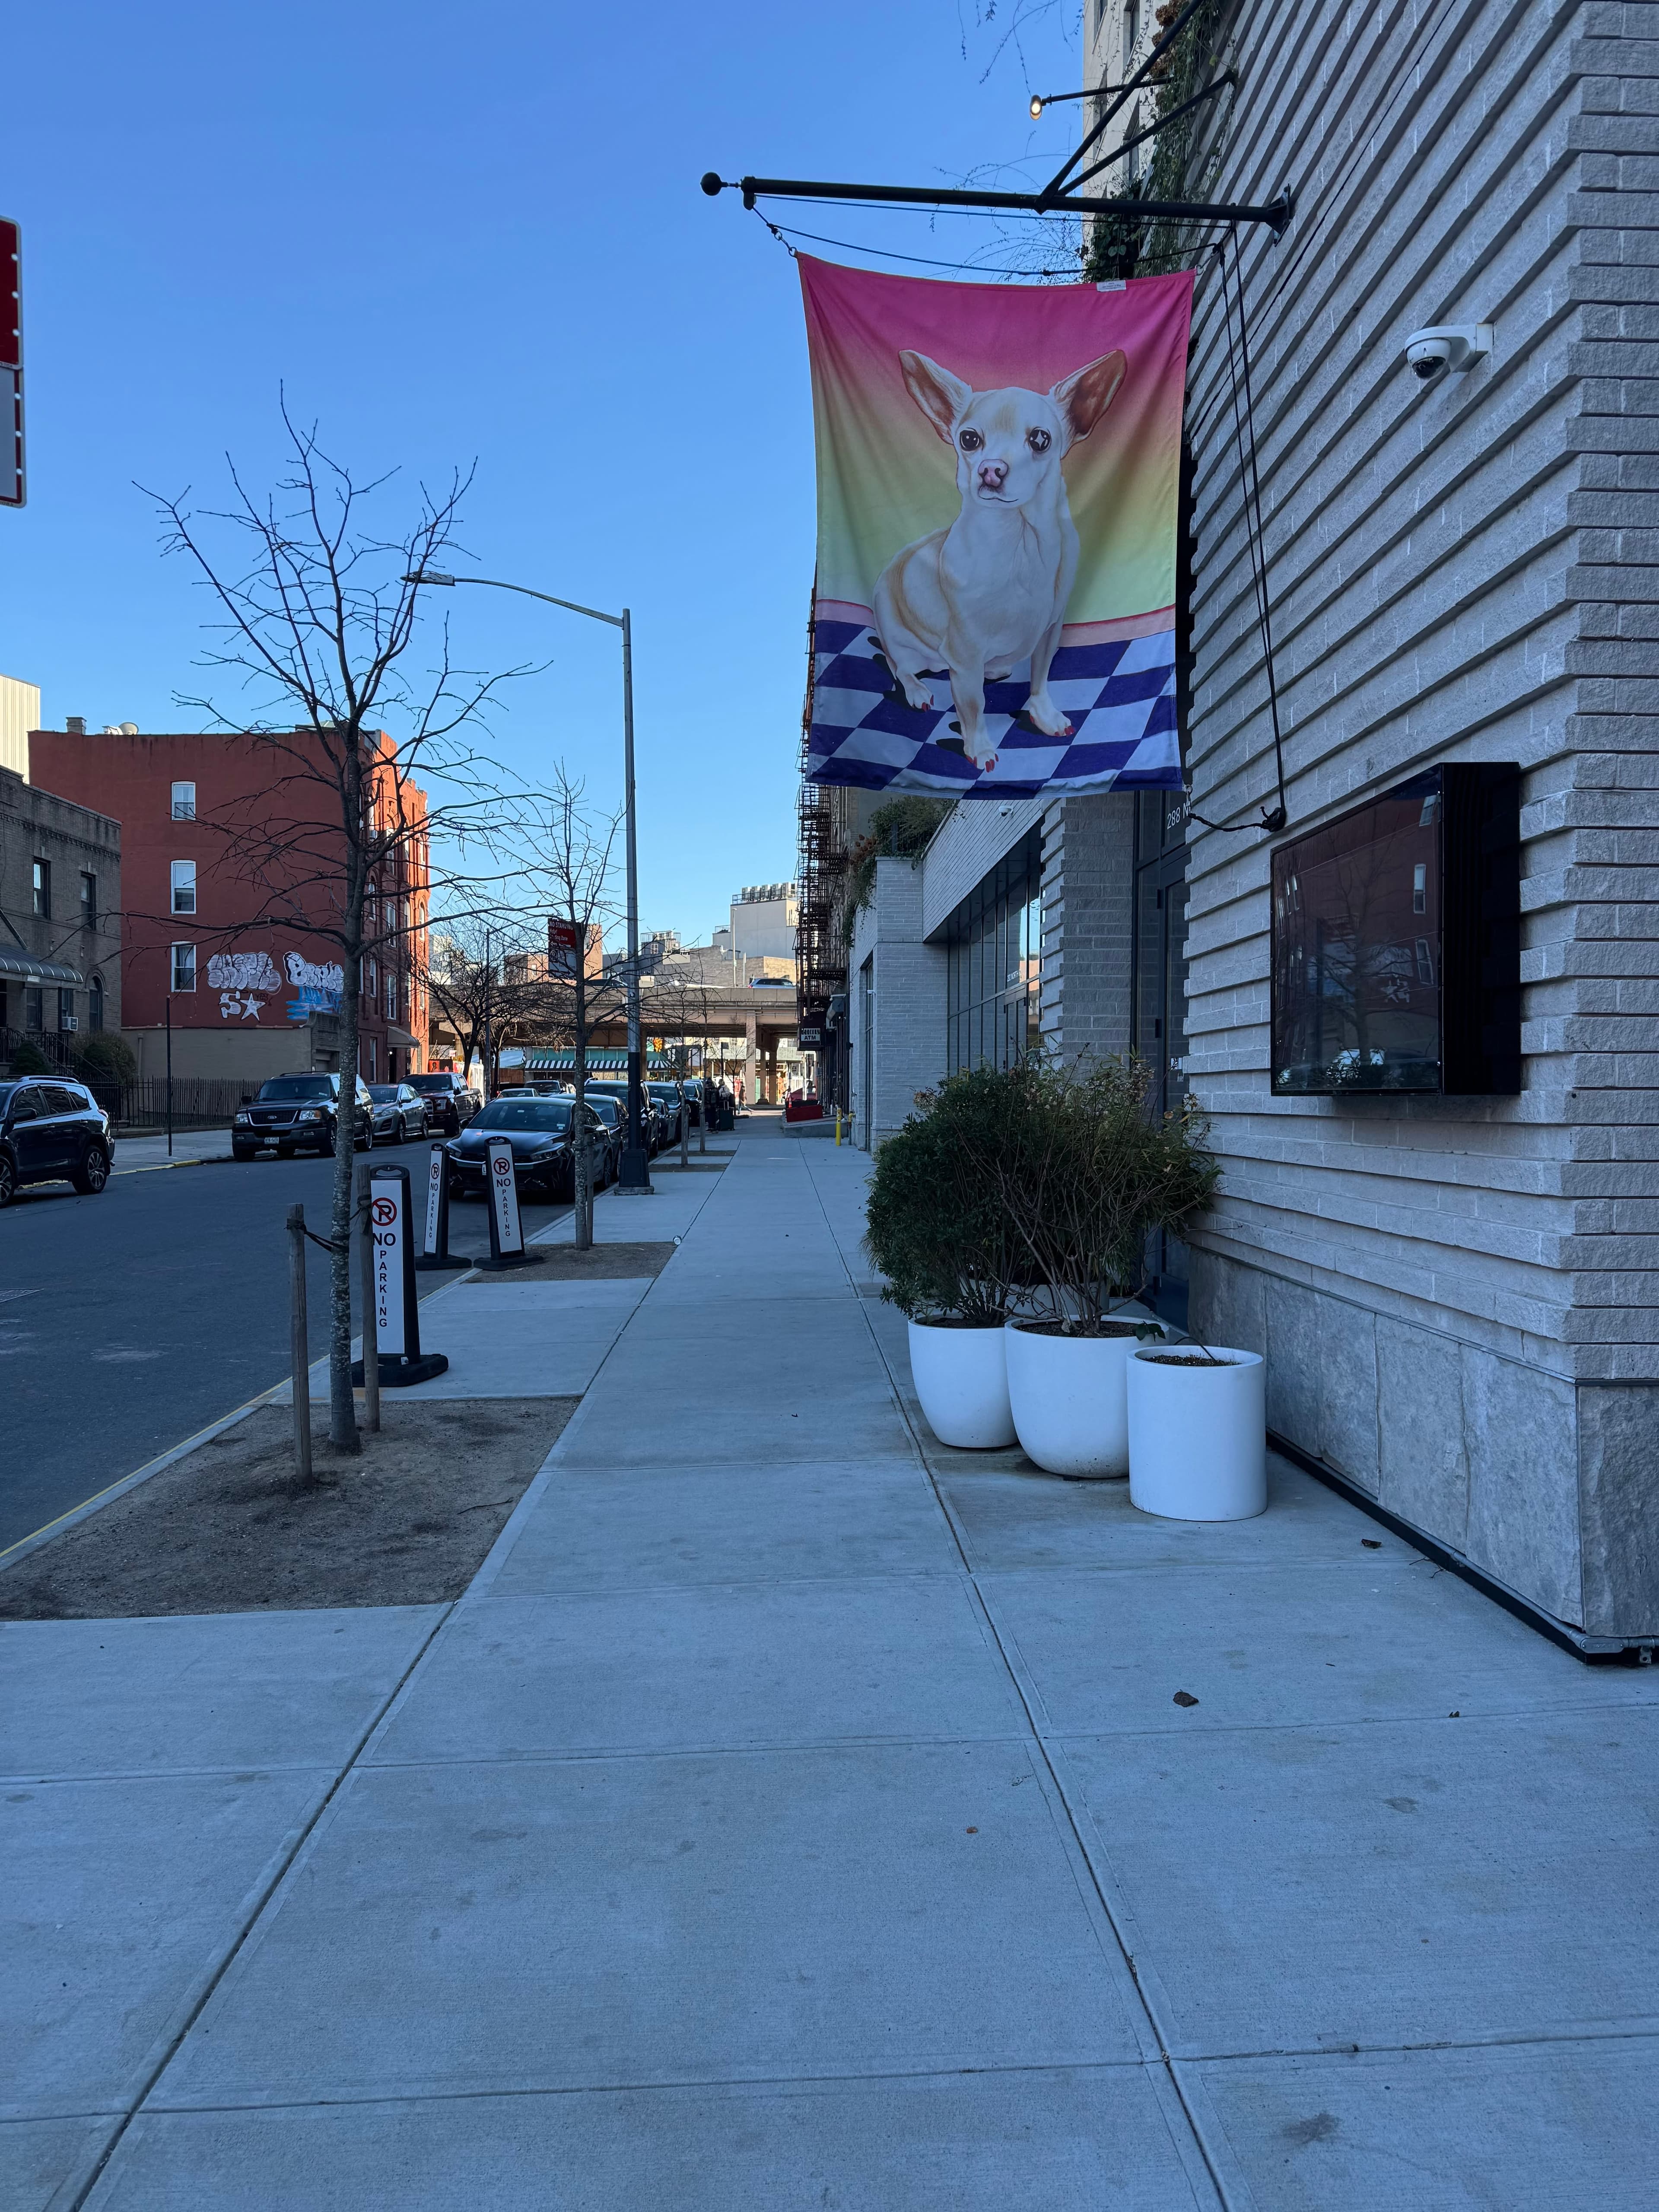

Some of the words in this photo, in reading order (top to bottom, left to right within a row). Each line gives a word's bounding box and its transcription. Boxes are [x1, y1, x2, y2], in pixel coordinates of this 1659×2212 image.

[1167, 807, 1180, 830] 288
[430, 1182, 438, 1192] NO
[496, 1178, 511, 1187] NO
[502, 1189, 511, 1236] PARKING
[373, 1233, 396, 1246] NO
[379, 1250, 387, 1327] PARKING
